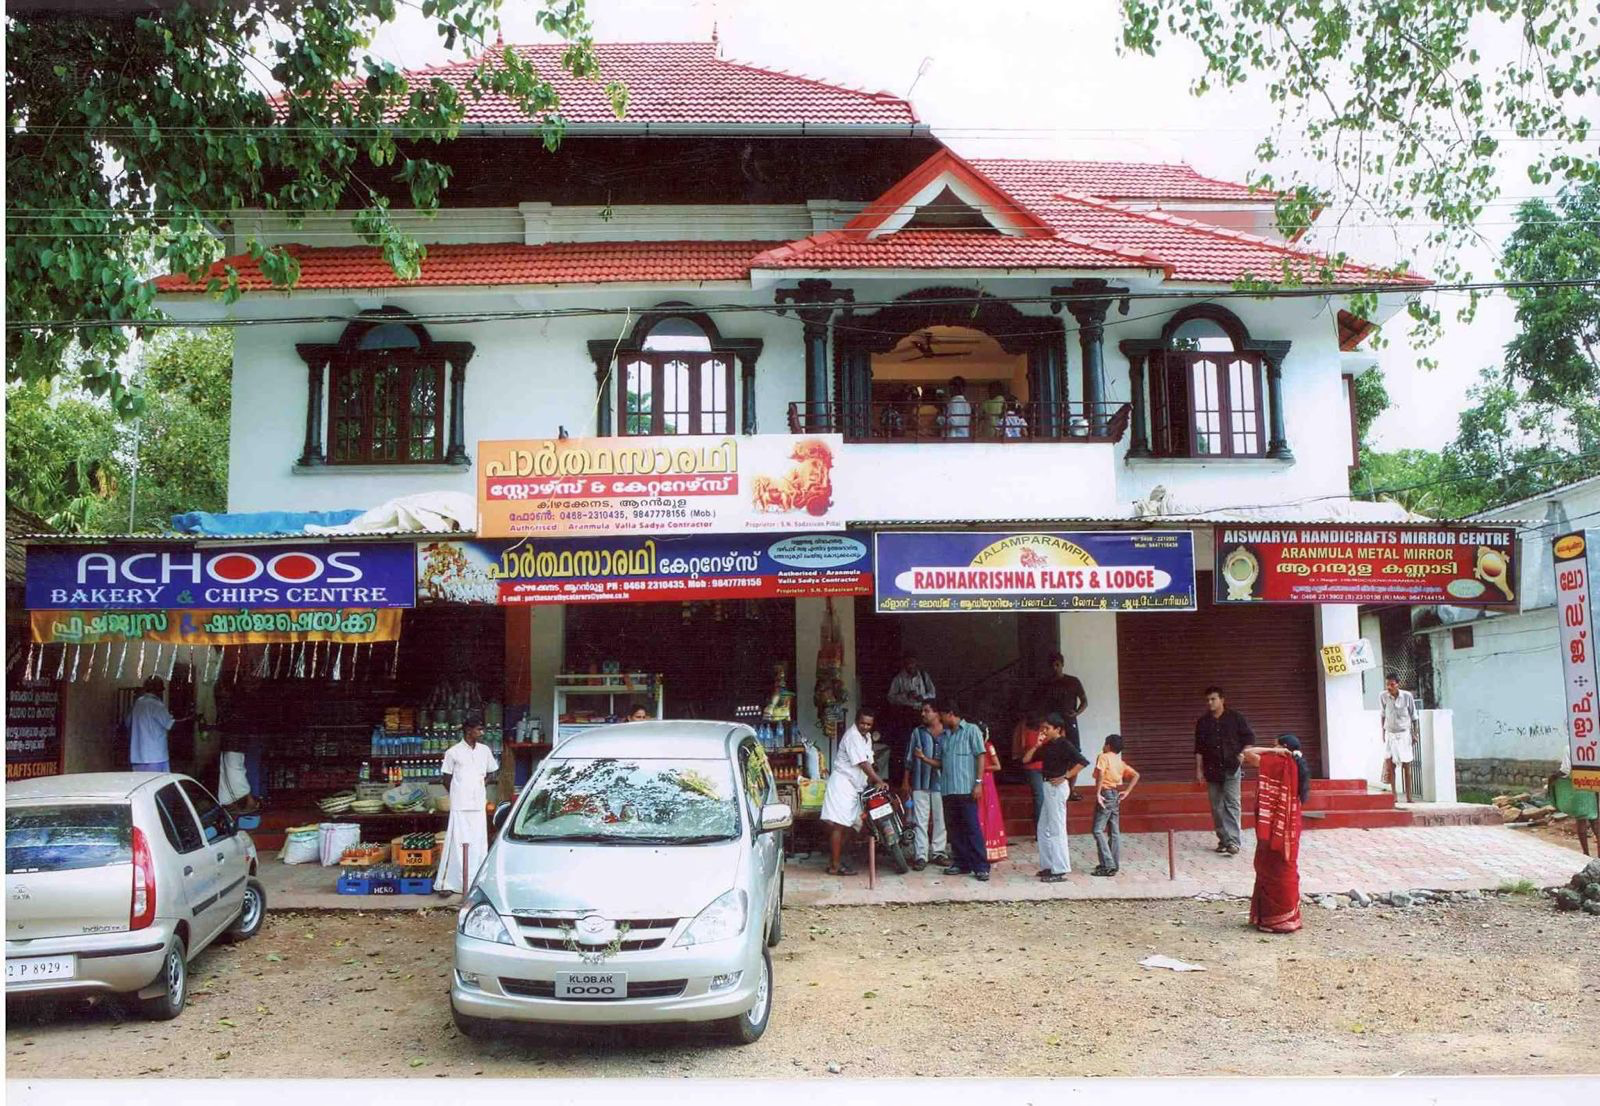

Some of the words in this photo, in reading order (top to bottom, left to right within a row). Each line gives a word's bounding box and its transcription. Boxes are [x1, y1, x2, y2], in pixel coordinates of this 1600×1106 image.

[591, 481, 607, 493] &
[632, 509, 687, 519] 9847778156
[568, 522, 610, 530] Aranmula
[639, 521, 666, 530] Sadya
[667, 520, 713, 529] Contractor
[1223, 530, 1298, 543] AISWARYA
[1301, 530, 1397, 544] HANDICRAFTS
[1400, 531, 1456, 545] MIRROR
[1459, 532, 1510, 545] CENTRE
[974, 535, 1091, 566] VALAMPARAMPIL
[1281, 547, 1354, 559] ARANMULA
[1357, 547, 1400, 559] METAL
[1403, 548, 1454, 560] MIRROR
[77, 552, 364, 584] ACHOOS
[914, 571, 1036, 589] RADHAKRISHNA
[1041, 571, 1084, 588] FLATS
[1089, 571, 1101, 588] &
[1106, 570, 1154, 588] LODGE
[51, 586, 164, 603] BAKERY
[177, 589, 195, 603] &
[205, 587, 282, 603] CHIPS
[286, 587, 386, 602] CENTRE
[1323, 646, 1341, 655] STD
[1327, 656, 1343, 664] ISD
[1328, 664, 1347, 673] PCO
[6, 763, 32, 778] RAFTS
[21, 964, 28, 975] P
[33, 963, 60, 974] 8929
[566, 986, 615, 994] 1000
